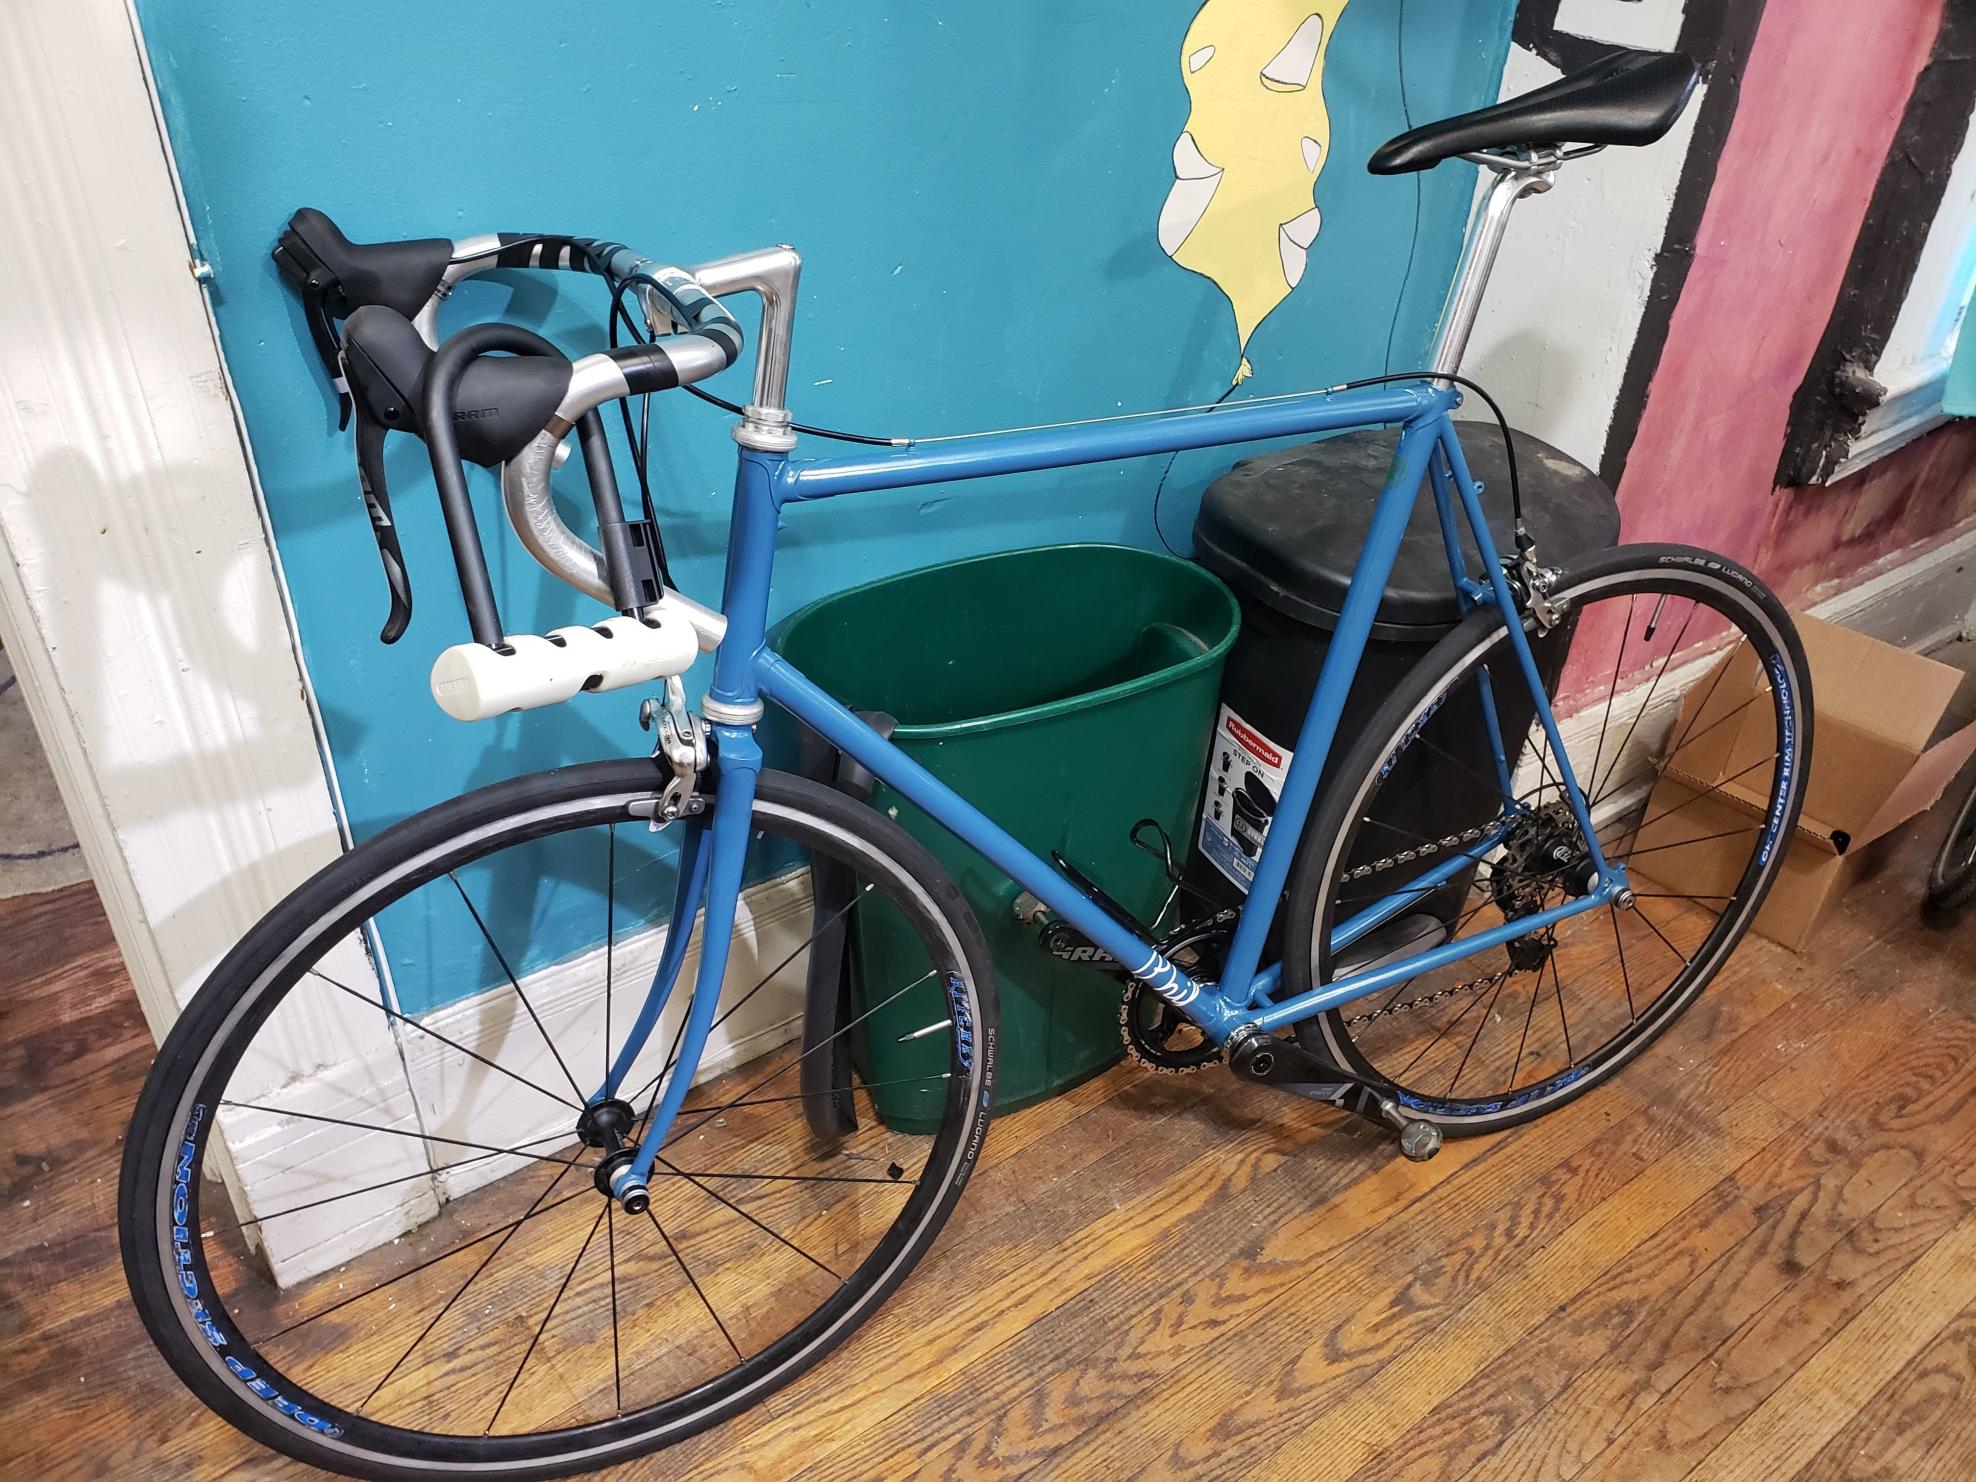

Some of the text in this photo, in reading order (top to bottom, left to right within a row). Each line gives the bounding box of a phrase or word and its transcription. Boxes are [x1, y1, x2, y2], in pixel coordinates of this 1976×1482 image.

[454, 407, 499, 421] RAM
[1228, 720, 1279, 764] Rubbermaid
[1233, 749, 1251, 766] STEP
[1252, 765, 1265, 778] ON
[1770, 785, 1787, 831] CENTER
[1781, 750, 1793, 778] RIM
[1051, 946, 1119, 961] SRA
[967, 1027, 996, 1160] SCHWALBE LUGANO
[173, 1142, 228, 1348] SECTION
